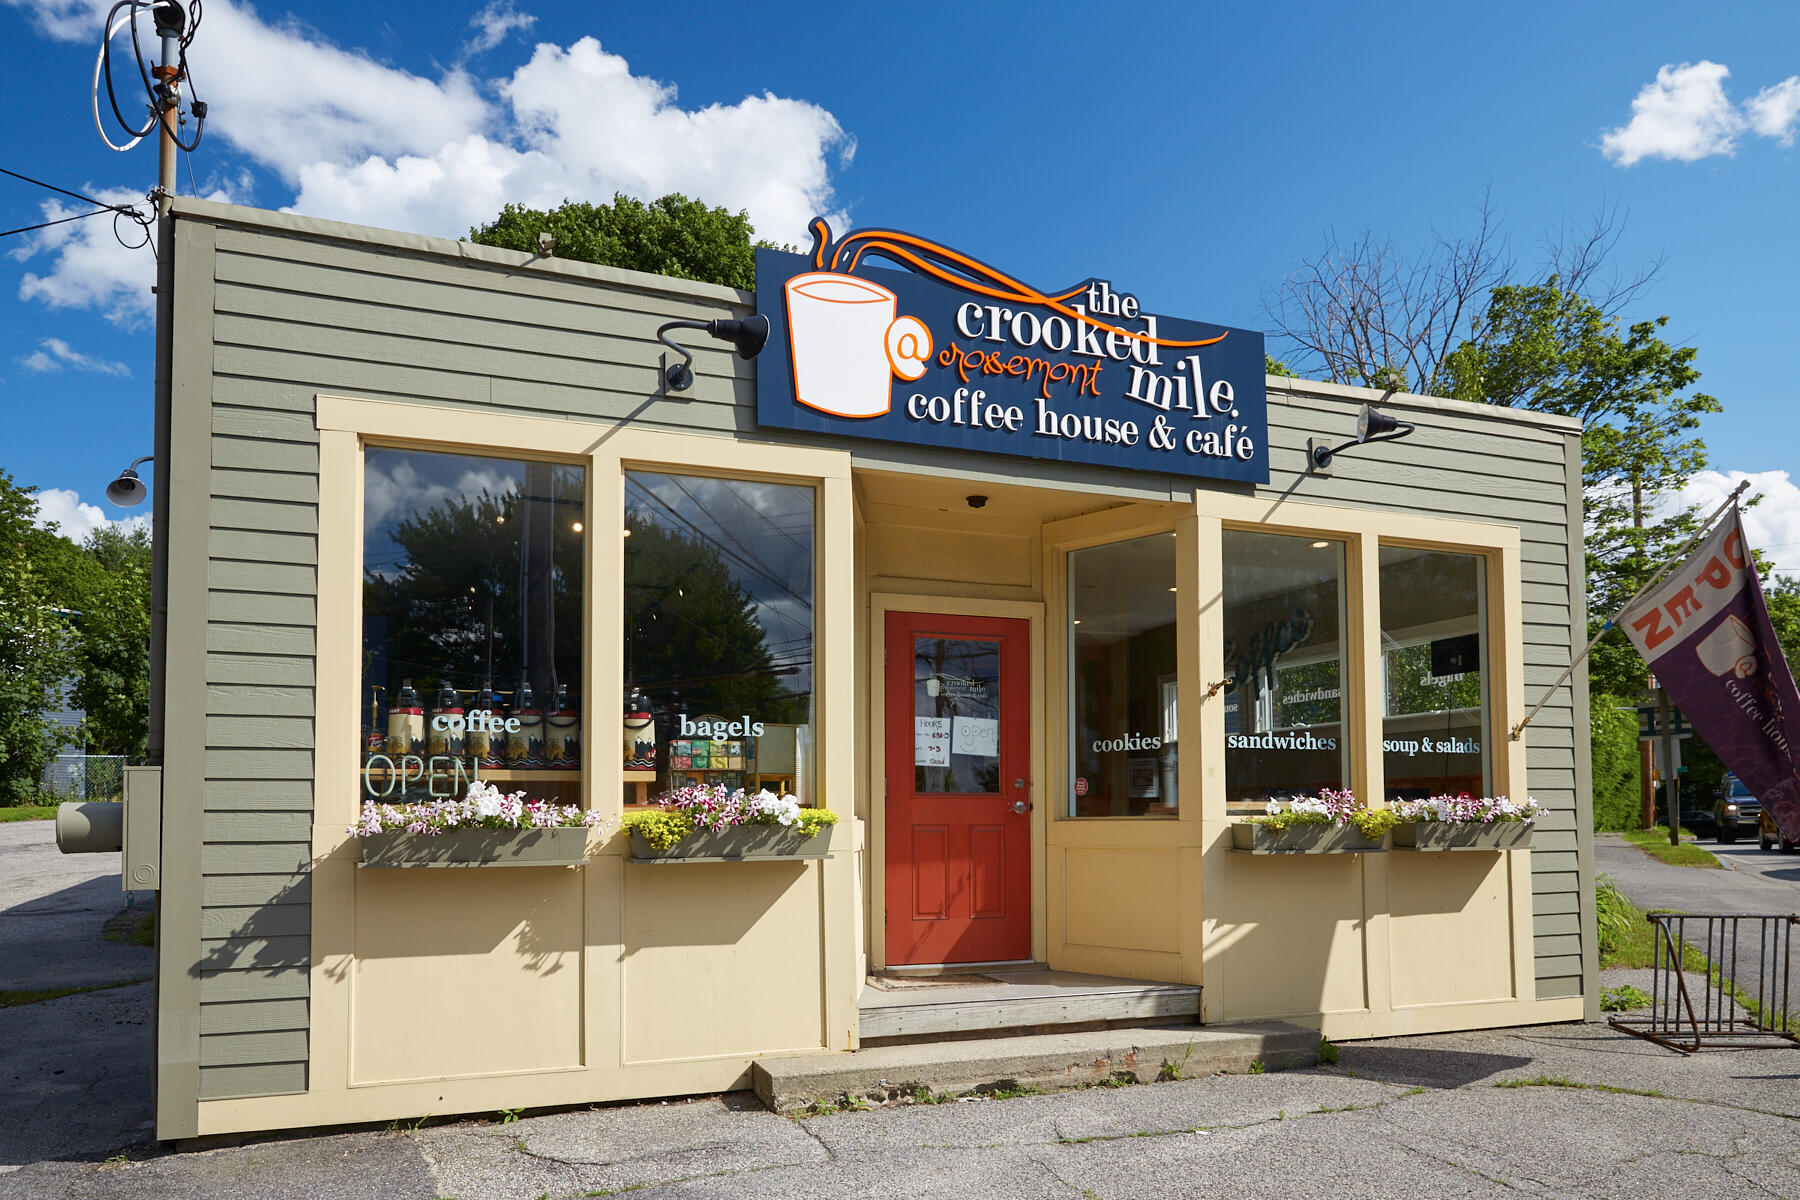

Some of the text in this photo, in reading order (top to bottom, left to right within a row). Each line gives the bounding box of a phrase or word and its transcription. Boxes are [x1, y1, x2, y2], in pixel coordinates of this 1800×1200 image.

[1086, 281, 1139, 318] the
[956, 302, 1163, 367] crooked
[938, 342, 1103, 399] rosemont
[907, 387, 1255, 461] coffee house & café
[1725, 679, 1763, 721] coffee
[432, 709, 521, 734] coffee
[679, 714, 765, 742] bagels
[1092, 731, 1162, 754] cookies
[1228, 730, 1337, 752] sandwiches
[1382, 736, 1481, 757] soup & salads
[364, 754, 480, 798] OPEN
